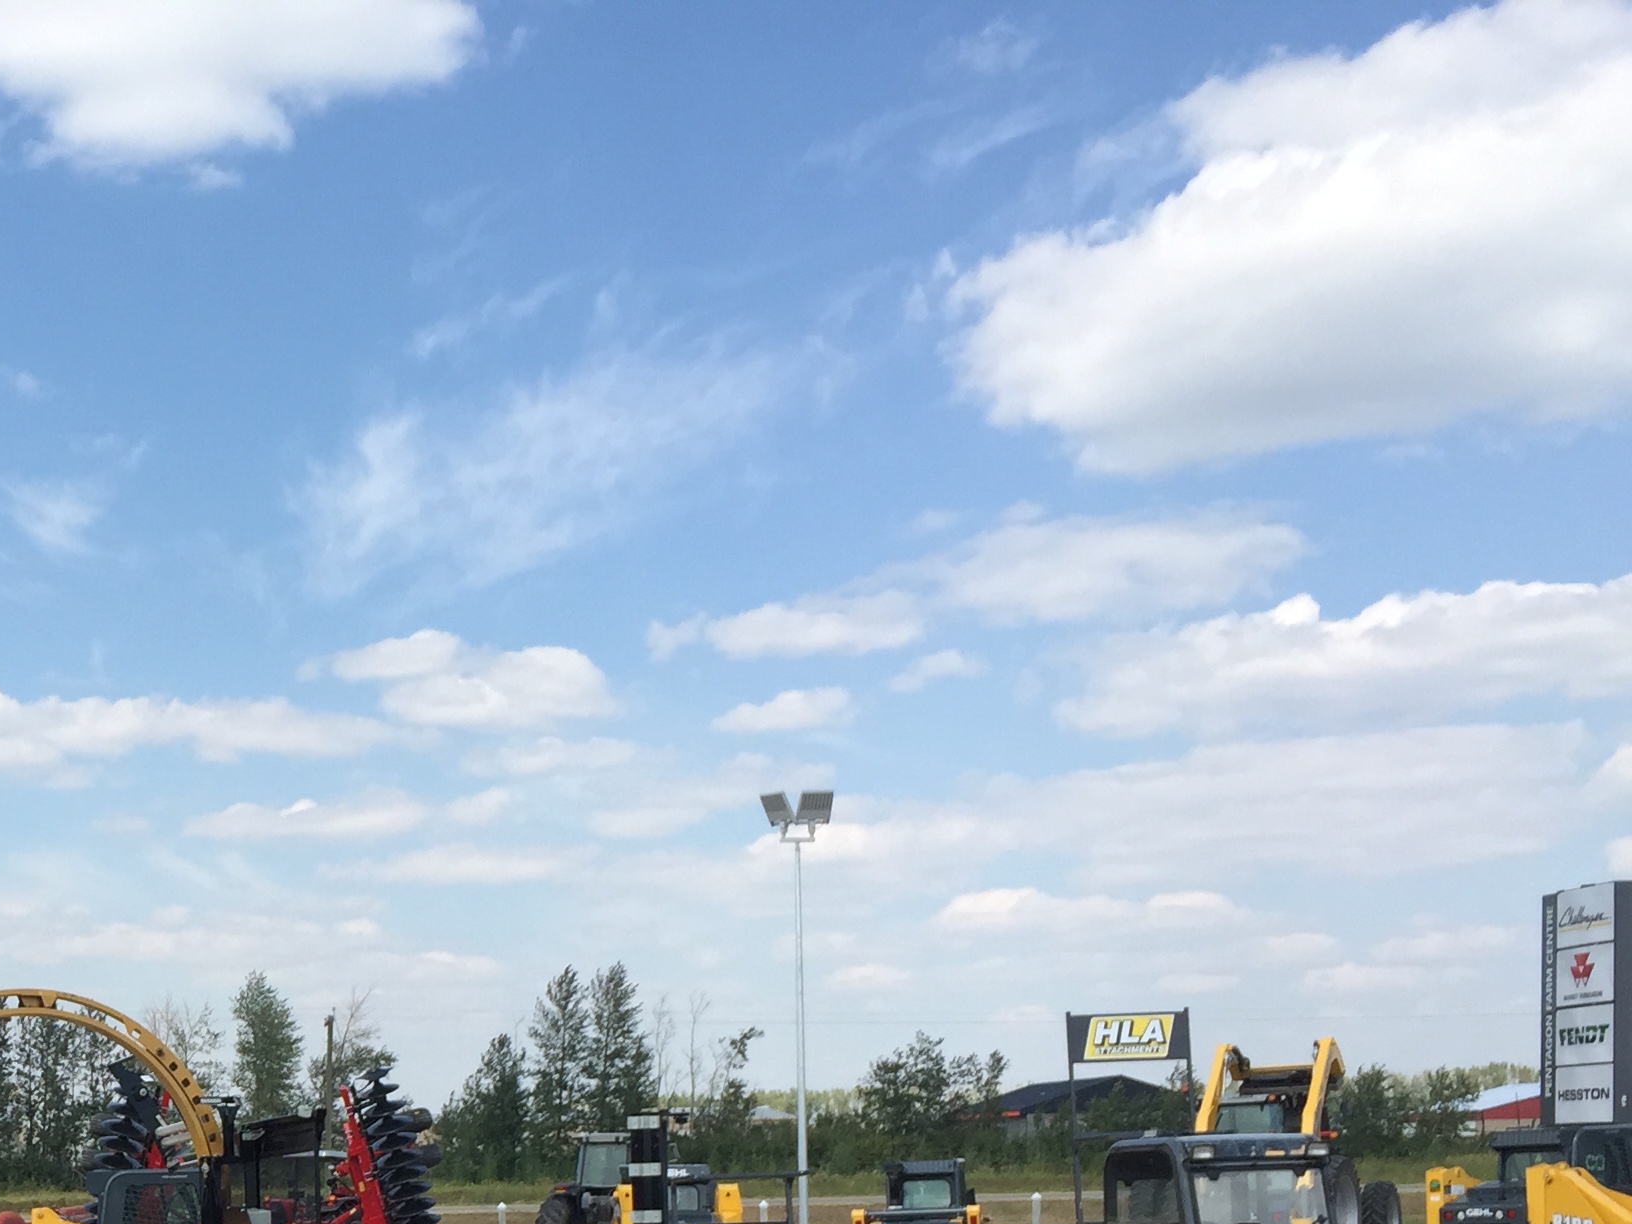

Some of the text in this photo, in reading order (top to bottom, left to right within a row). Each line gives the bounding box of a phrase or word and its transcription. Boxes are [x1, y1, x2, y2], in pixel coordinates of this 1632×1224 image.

[1545, 905, 1554, 1098] PENTAGON FARM CENTRE
[1094, 1018, 1167, 1046] HLA
[1559, 1024, 1610, 1046] FENDT
[1093, 1043, 1165, 1055] ATTACHMENTS
[1558, 1087, 1610, 1101] HESSTON
[1466, 1208, 1494, 1217] GEHL
